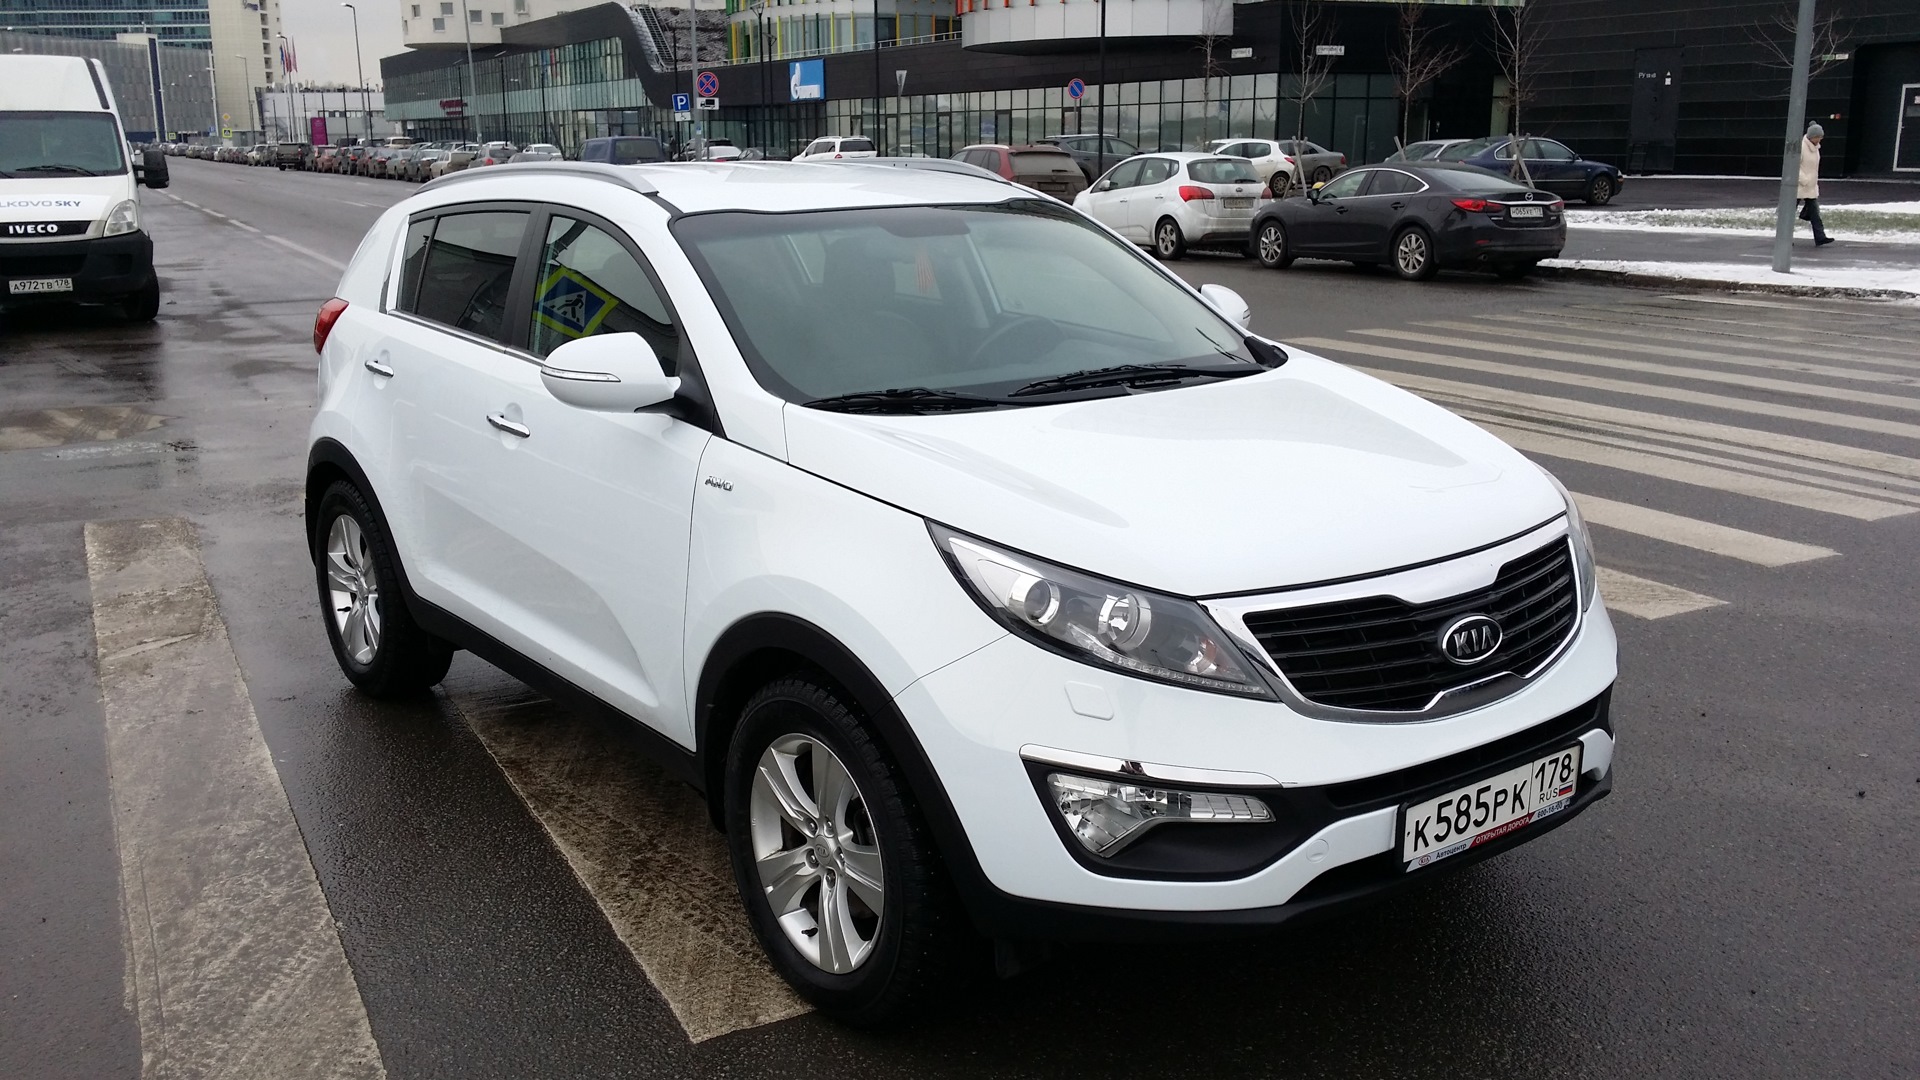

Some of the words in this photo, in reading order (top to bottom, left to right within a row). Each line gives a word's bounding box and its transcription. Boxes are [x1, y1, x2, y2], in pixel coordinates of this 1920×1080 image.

[677, 96, 687, 110] P
[55, 200, 81, 208] SKY
[8, 224, 58, 234] IVECO
[1453, 625, 1495, 657] KIA
[1534, 753, 1573, 793] 178
[1538, 787, 1558, 804] RUS
[1436, 843, 1467, 859] Автоцентр
[1475, 828, 1507, 844] ОТКРЫТАЯ
[1507, 816, 1530, 833] ДОРОГА
